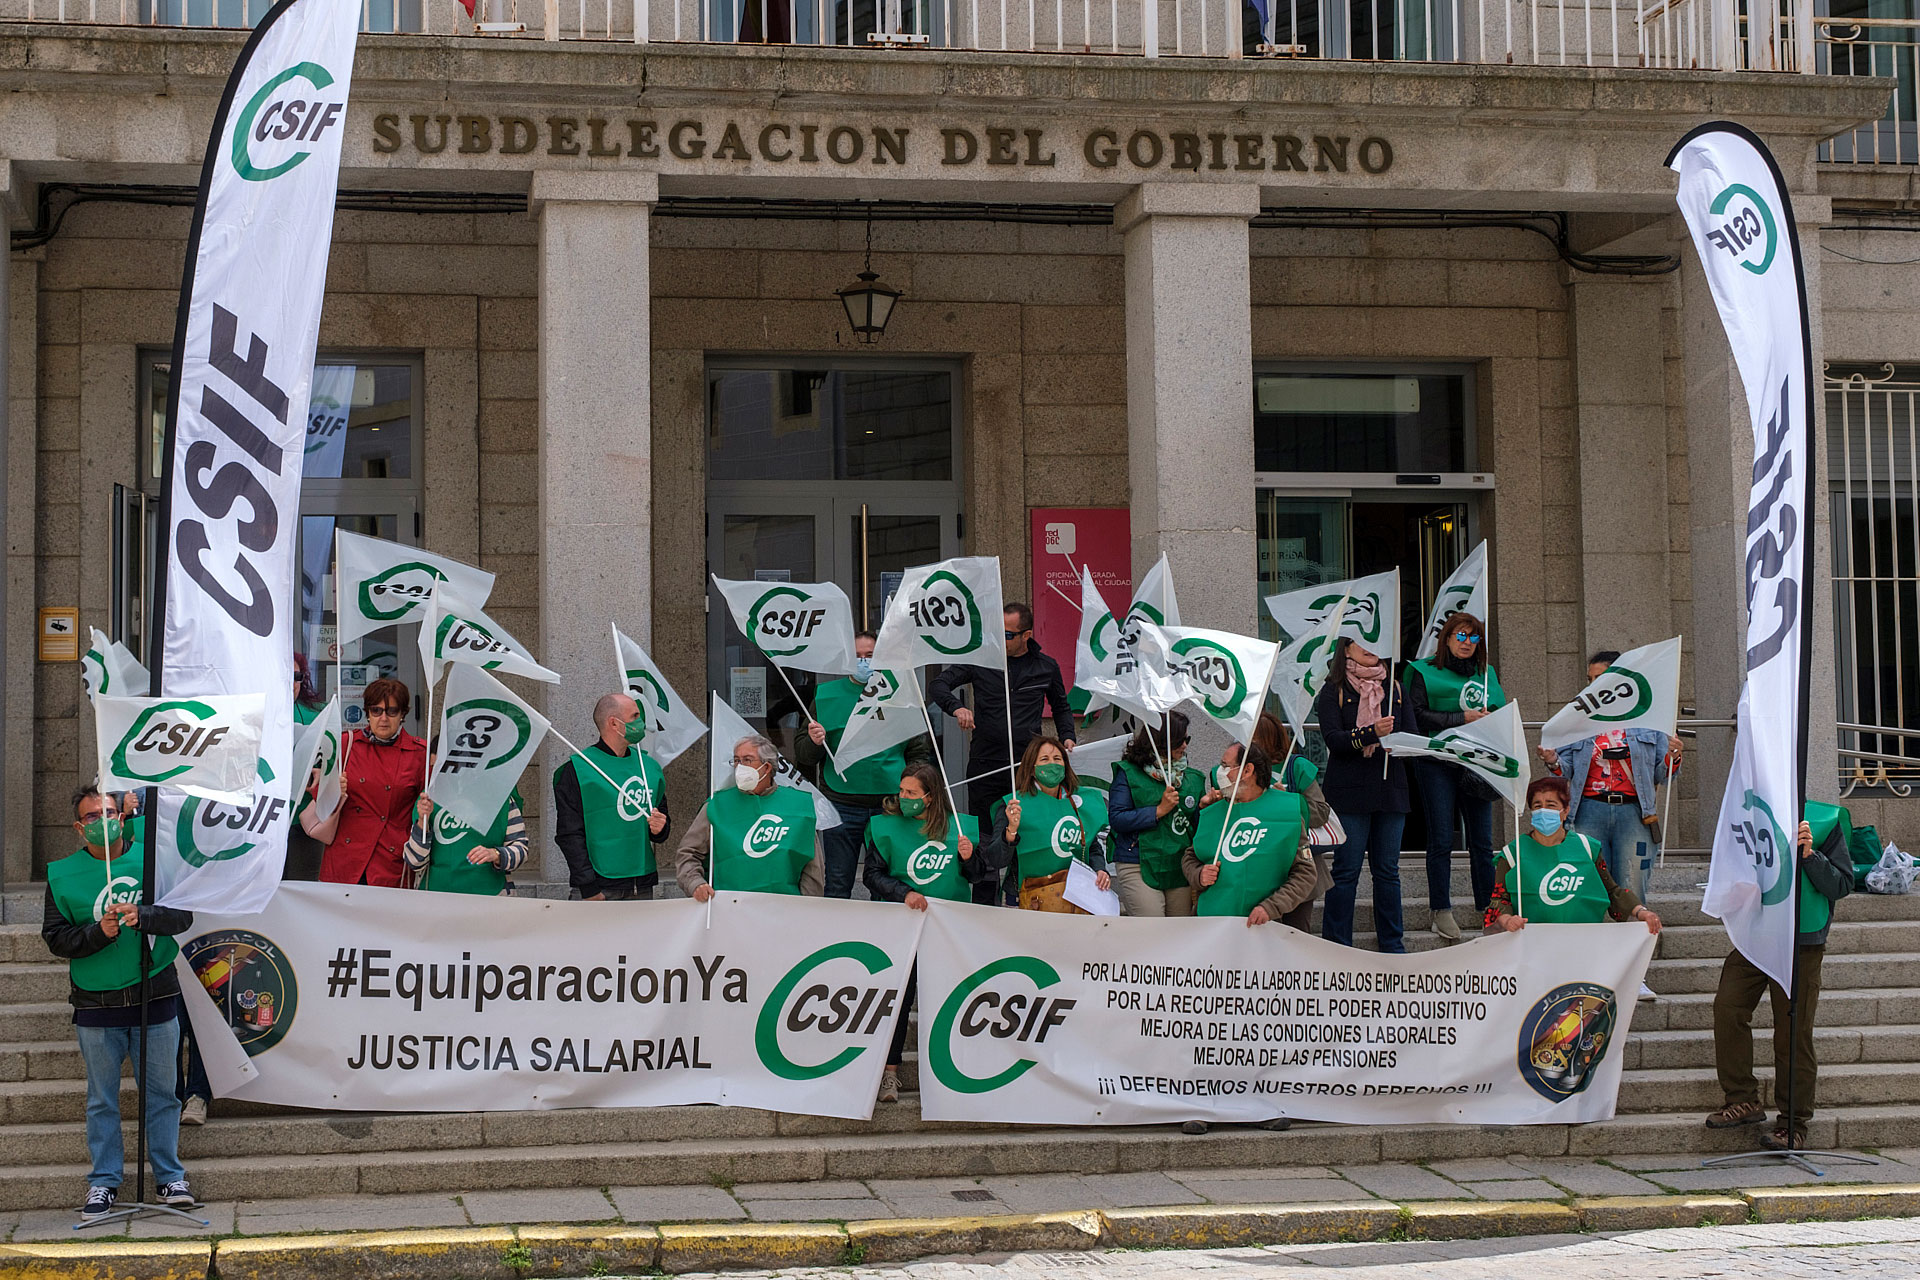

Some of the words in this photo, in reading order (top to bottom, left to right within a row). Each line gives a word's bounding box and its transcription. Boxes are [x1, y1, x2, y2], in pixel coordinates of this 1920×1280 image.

[255, 99, 344, 143] CSIF
[373, 114, 909, 165] SUBDELEGACION
[941, 128, 1055, 168] DEL
[1083, 129, 1394, 175] GOBIERNO
[176, 301, 289, 638] CSIF
[761, 609, 826, 638] CSIF
[134, 722, 230, 758] CSIF
[625, 789, 653, 806] CSIF
[753, 826, 790, 845] CSIF
[1231, 828, 1268, 848] CSIF
[916, 854, 953, 871] CSIF
[1549, 875, 1585, 892] CSIF
[327, 947, 748, 1012] #EquiparacionYa
[1082, 962, 1109, 982] POR
[1111, 963, 1128, 984] LA
[1130, 964, 1223, 990] DIGNIFICACIÓN
[1225, 970, 1241, 990] DE
[1244, 970, 1259, 990] LA
[1262, 971, 1301, 991] LABOR
[1304, 971, 1320, 991] DE
[1322, 972, 1372, 992] LAS/LOS
[1375, 973, 1452, 994] EMPLEADOS
[1455, 969, 1517, 996] PÚBLICOS
[786, 984, 899, 1035] CSIF
[959, 991, 1077, 1044] CSIF
[1107, 990, 1141, 1011] POR
[1146, 993, 1166, 1012] LA
[1170, 993, 1291, 1017] RECUPERACIÓN
[1295, 998, 1324, 1017] DEL
[1328, 999, 1382, 1019] PODER
[1386, 1001, 1486, 1021] ADQUISITIVO
[1140, 1018, 1204, 1040] MEJORA
[1207, 1022, 1228, 1041] DE
[1231, 1022, 1259, 1042] LAS
[1263, 1023, 1362, 1044] CONDICIONES
[1366, 1025, 1457, 1045] LABORALES
[348, 1034, 519, 1072] JUSTICIA
[529, 1036, 712, 1074] SALARIAL
[1193, 1046, 1255, 1067] MEJORA
[1259, 1049, 1278, 1067] DE
[1281, 1049, 1309, 1066] LAS
[1312, 1049, 1397, 1069] PENSIONES
[1119, 1075, 1248, 1097] DEFENDEMOS
[1252, 1079, 1357, 1097] NUESTROS
[1362, 1084, 1469, 1097] DERECHOS
[1474, 1082, 1493, 1095] !!!
